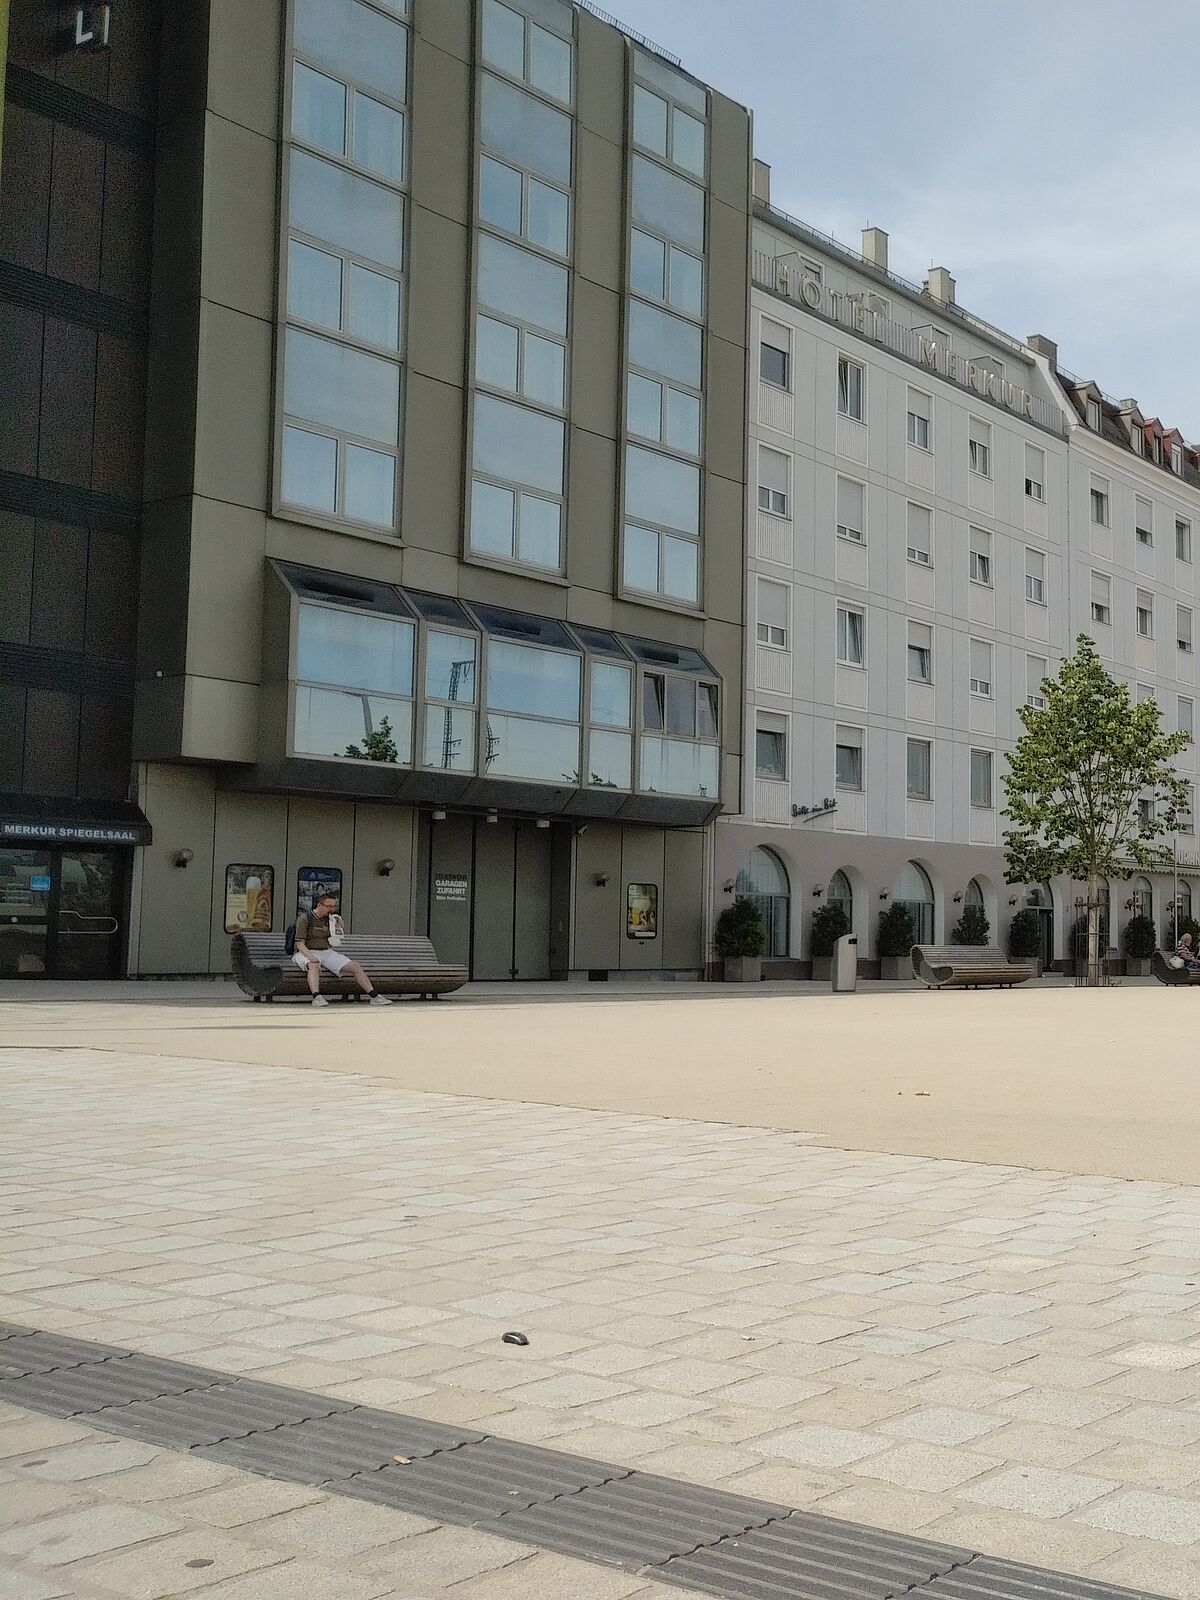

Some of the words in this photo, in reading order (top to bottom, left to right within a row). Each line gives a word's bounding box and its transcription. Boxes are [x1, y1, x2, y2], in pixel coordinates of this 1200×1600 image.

[775, 265, 884, 342] HOTEL
[918, 335, 1033, 420] MERKUR
[791, 803, 810, 817] Bitte
[811, 804, 823, 813] ein
[823, 797, 838, 810] Bit
[4, 824, 56, 836] MERKUR
[59, 828, 136, 840] SPIEGELSAAL
[435, 879, 468, 888] GARAGEN
[436, 887, 466, 895] ZUFAHRT
